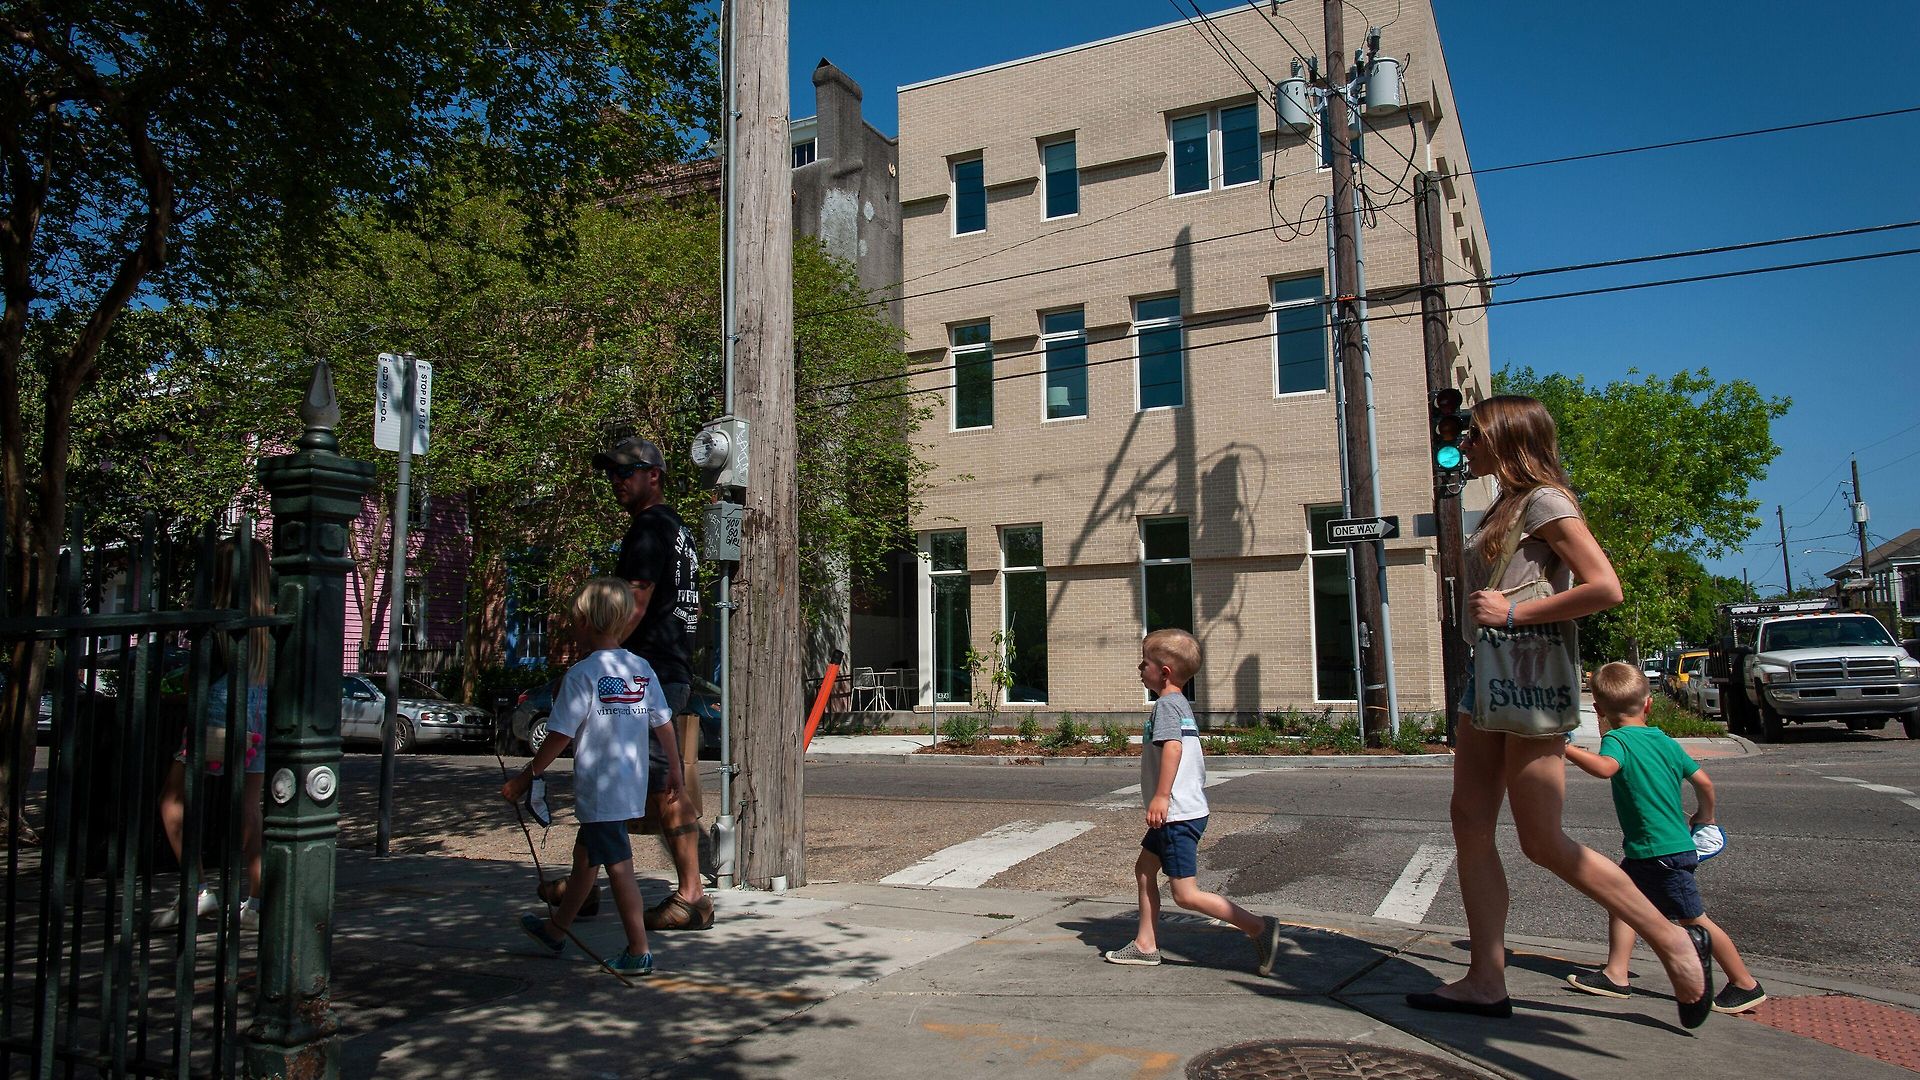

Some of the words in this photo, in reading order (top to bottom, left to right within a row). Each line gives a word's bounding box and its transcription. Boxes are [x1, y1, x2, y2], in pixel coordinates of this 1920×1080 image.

[420, 397, 427, 406] ID
[726, 519, 740, 530] YOU
[1335, 526, 1355, 536] ONE
[1356, 524, 1377, 534] WAY
[728, 528, 738, 537] GO
[1489, 678, 1572, 712] Stones
